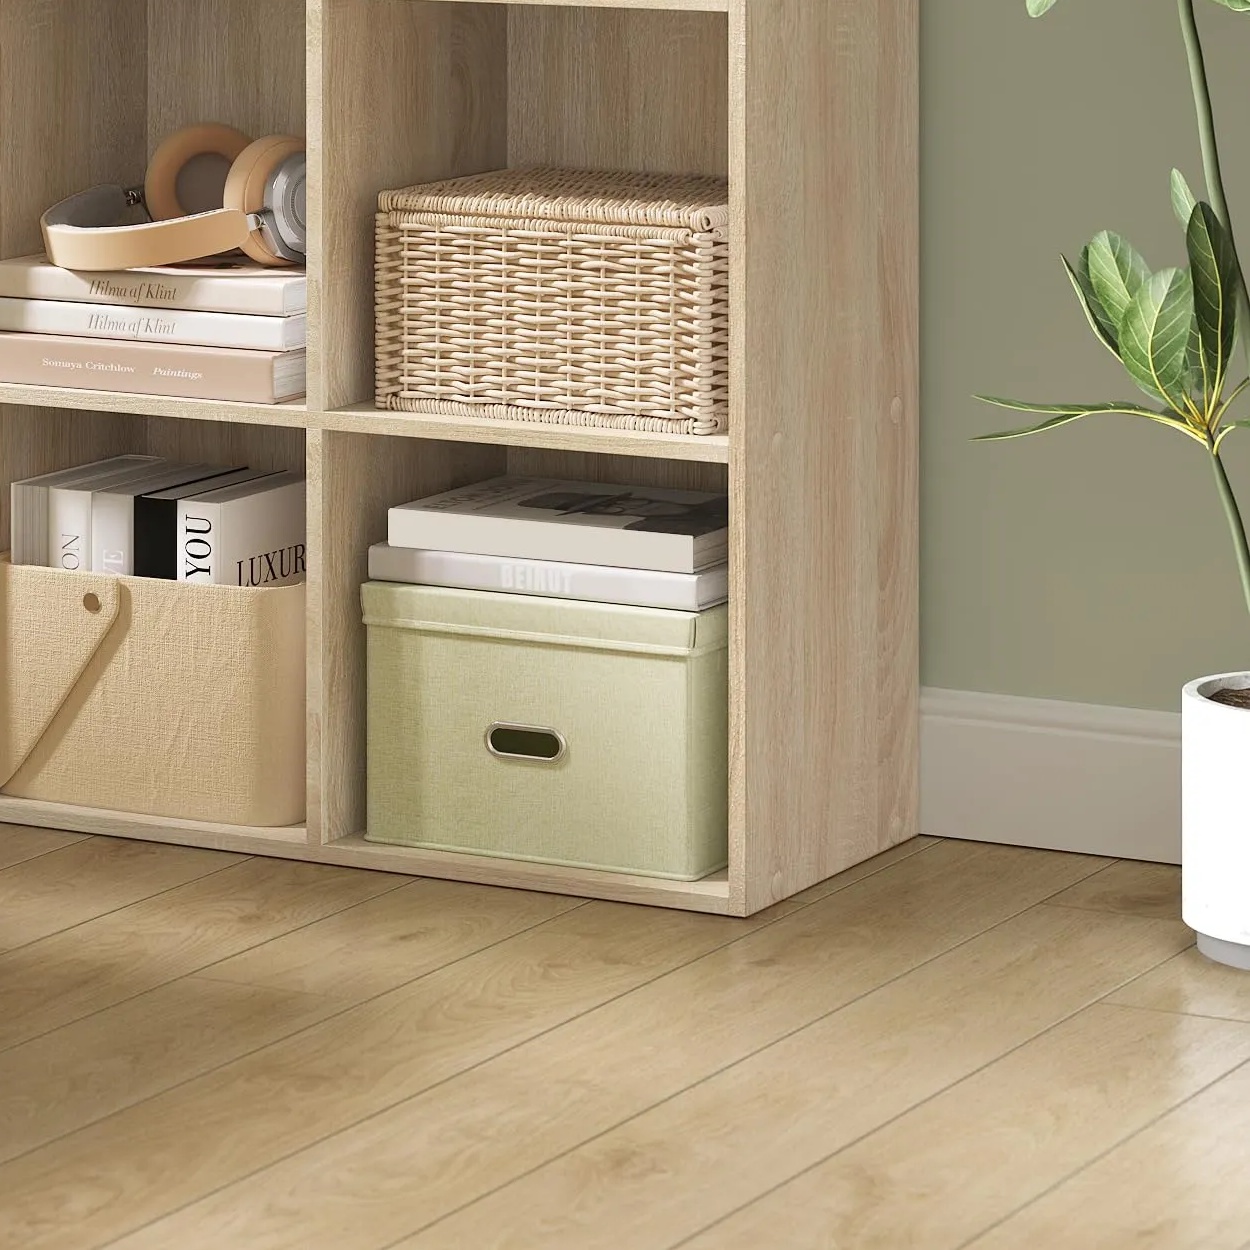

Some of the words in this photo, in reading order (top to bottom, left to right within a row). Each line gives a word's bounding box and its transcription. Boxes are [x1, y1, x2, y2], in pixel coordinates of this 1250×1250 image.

[89, 279, 127, 298] Hilma
[129, 282, 146, 303] af
[146, 283, 177, 301] Klint
[88, 313, 126, 331] Hilma
[128, 316, 145, 338] af
[144, 317, 176, 335] Klint
[42, 358, 83, 370] Somaya
[85, 361, 136, 373] Critchlow
[153, 367, 203, 380] Paintings
[61, 533, 80, 571] ON
[184, 513, 212, 579] YOU
